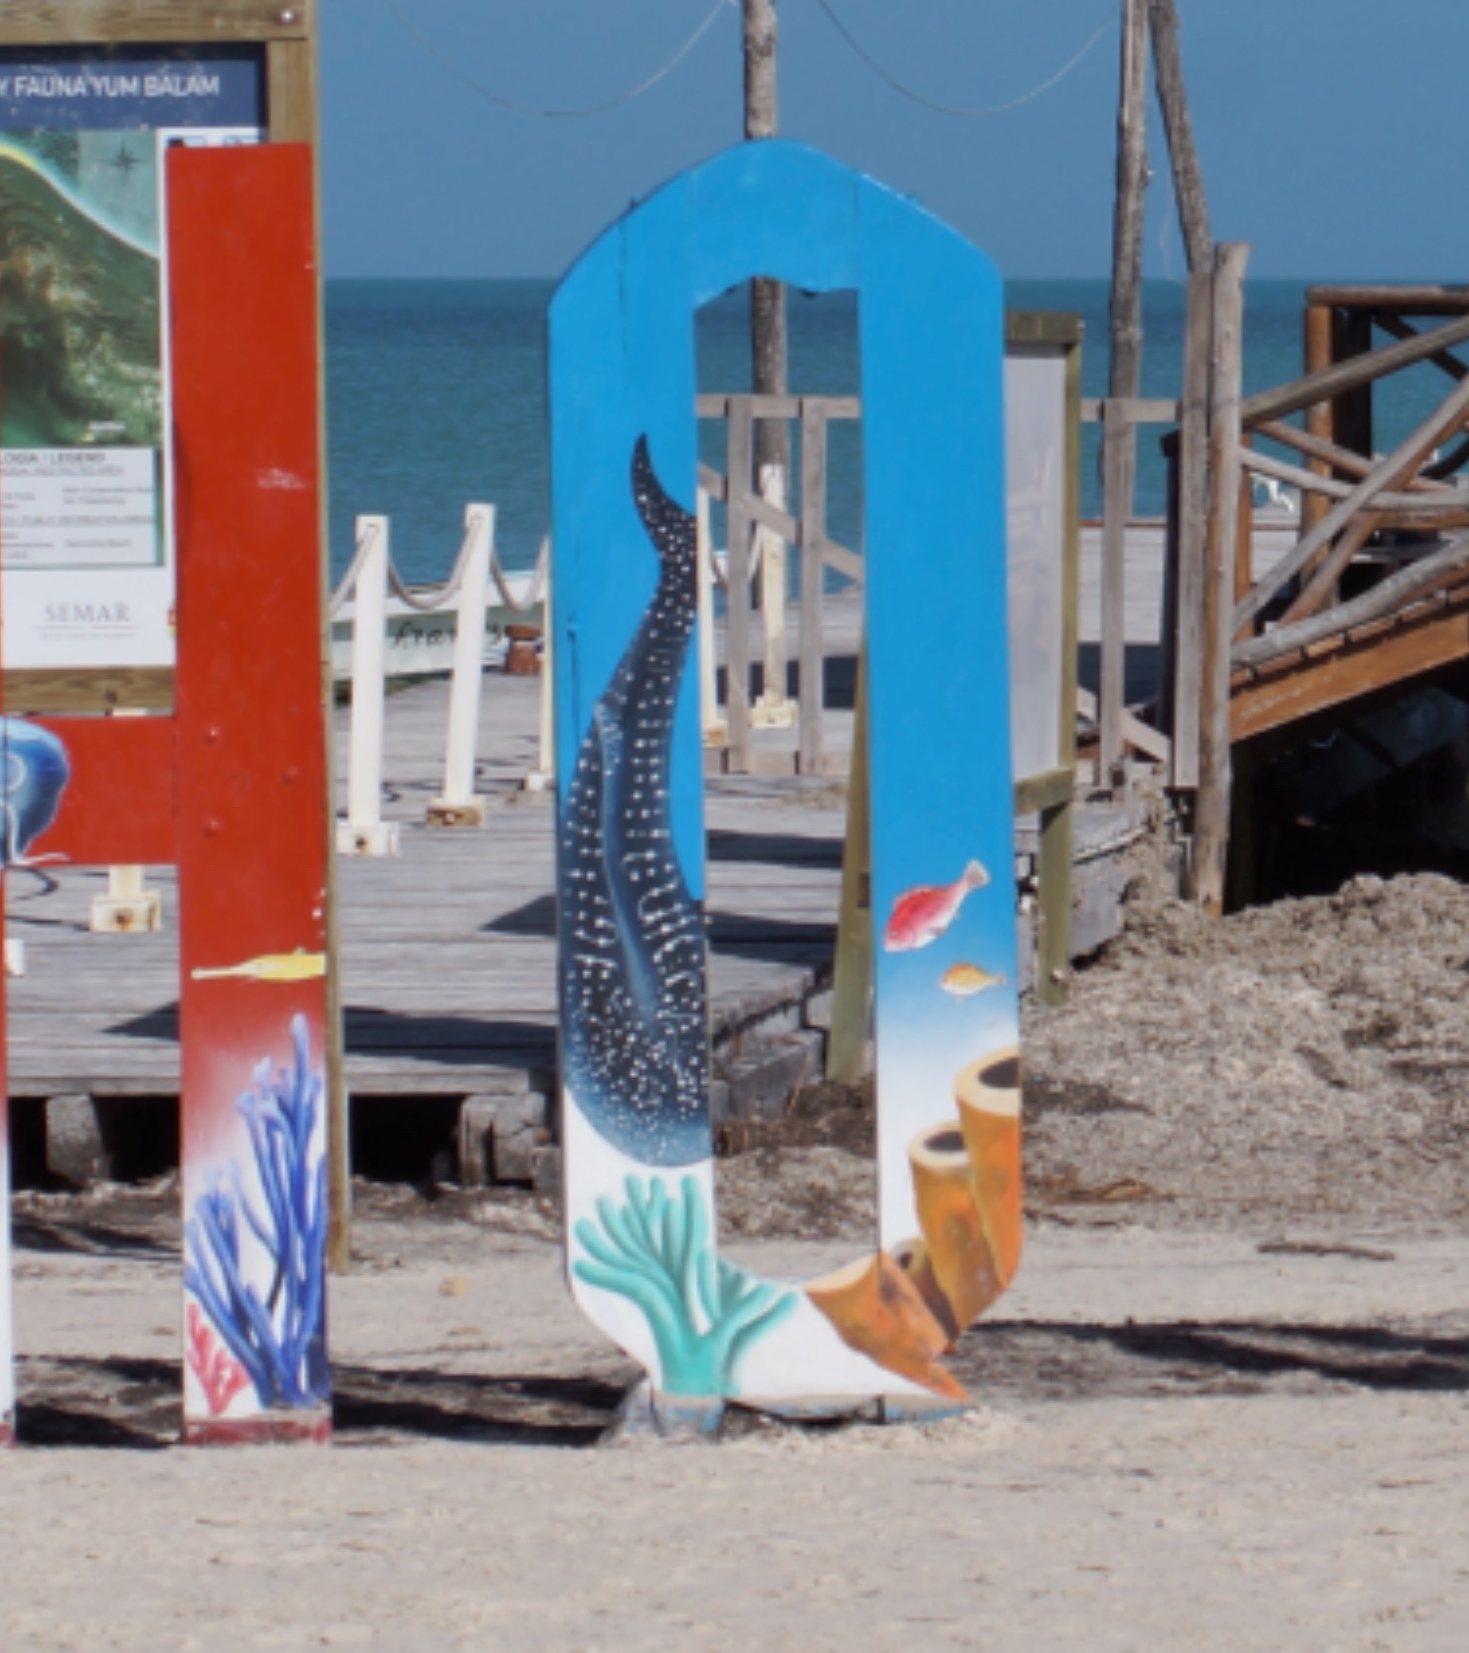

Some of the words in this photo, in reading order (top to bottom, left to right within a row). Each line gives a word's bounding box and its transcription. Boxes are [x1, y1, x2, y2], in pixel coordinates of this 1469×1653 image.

[14, 74, 87, 98] FAUNA
[87, 75, 139, 98] YUM
[142, 74, 220, 97] BALAM
[44, 602, 130, 622] SEMAR
